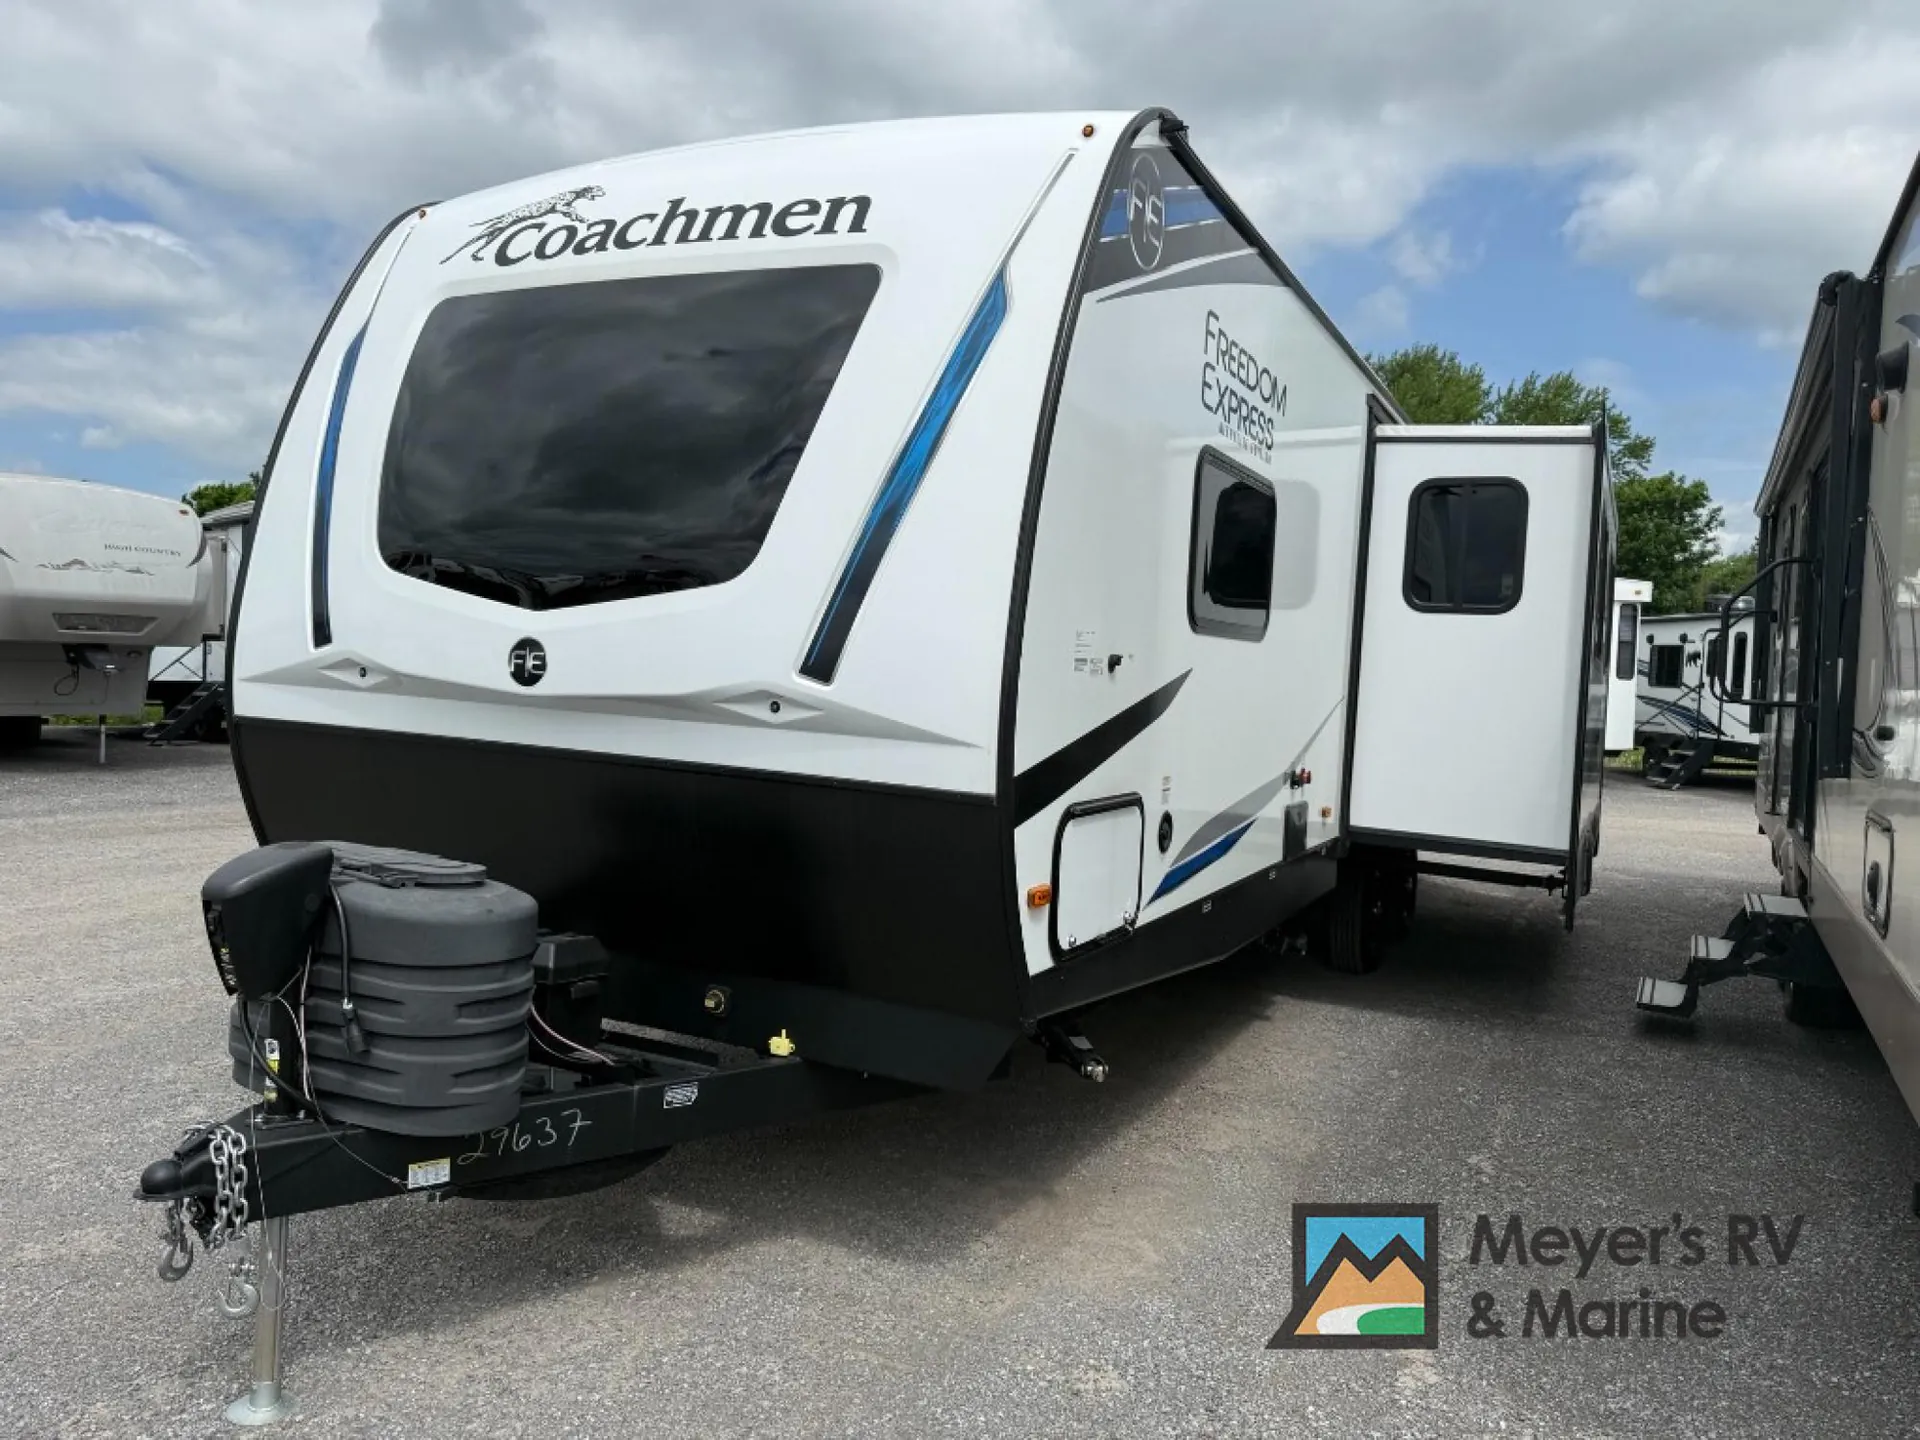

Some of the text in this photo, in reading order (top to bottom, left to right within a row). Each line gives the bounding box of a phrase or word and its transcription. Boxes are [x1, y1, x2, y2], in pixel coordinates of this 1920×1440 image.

[494, 194, 872, 267] Coachmen
[1204, 309, 1287, 417] FREEDOM
[1201, 361, 1274, 450] EXPRESS
[456, 1108, 595, 1165] 29637
